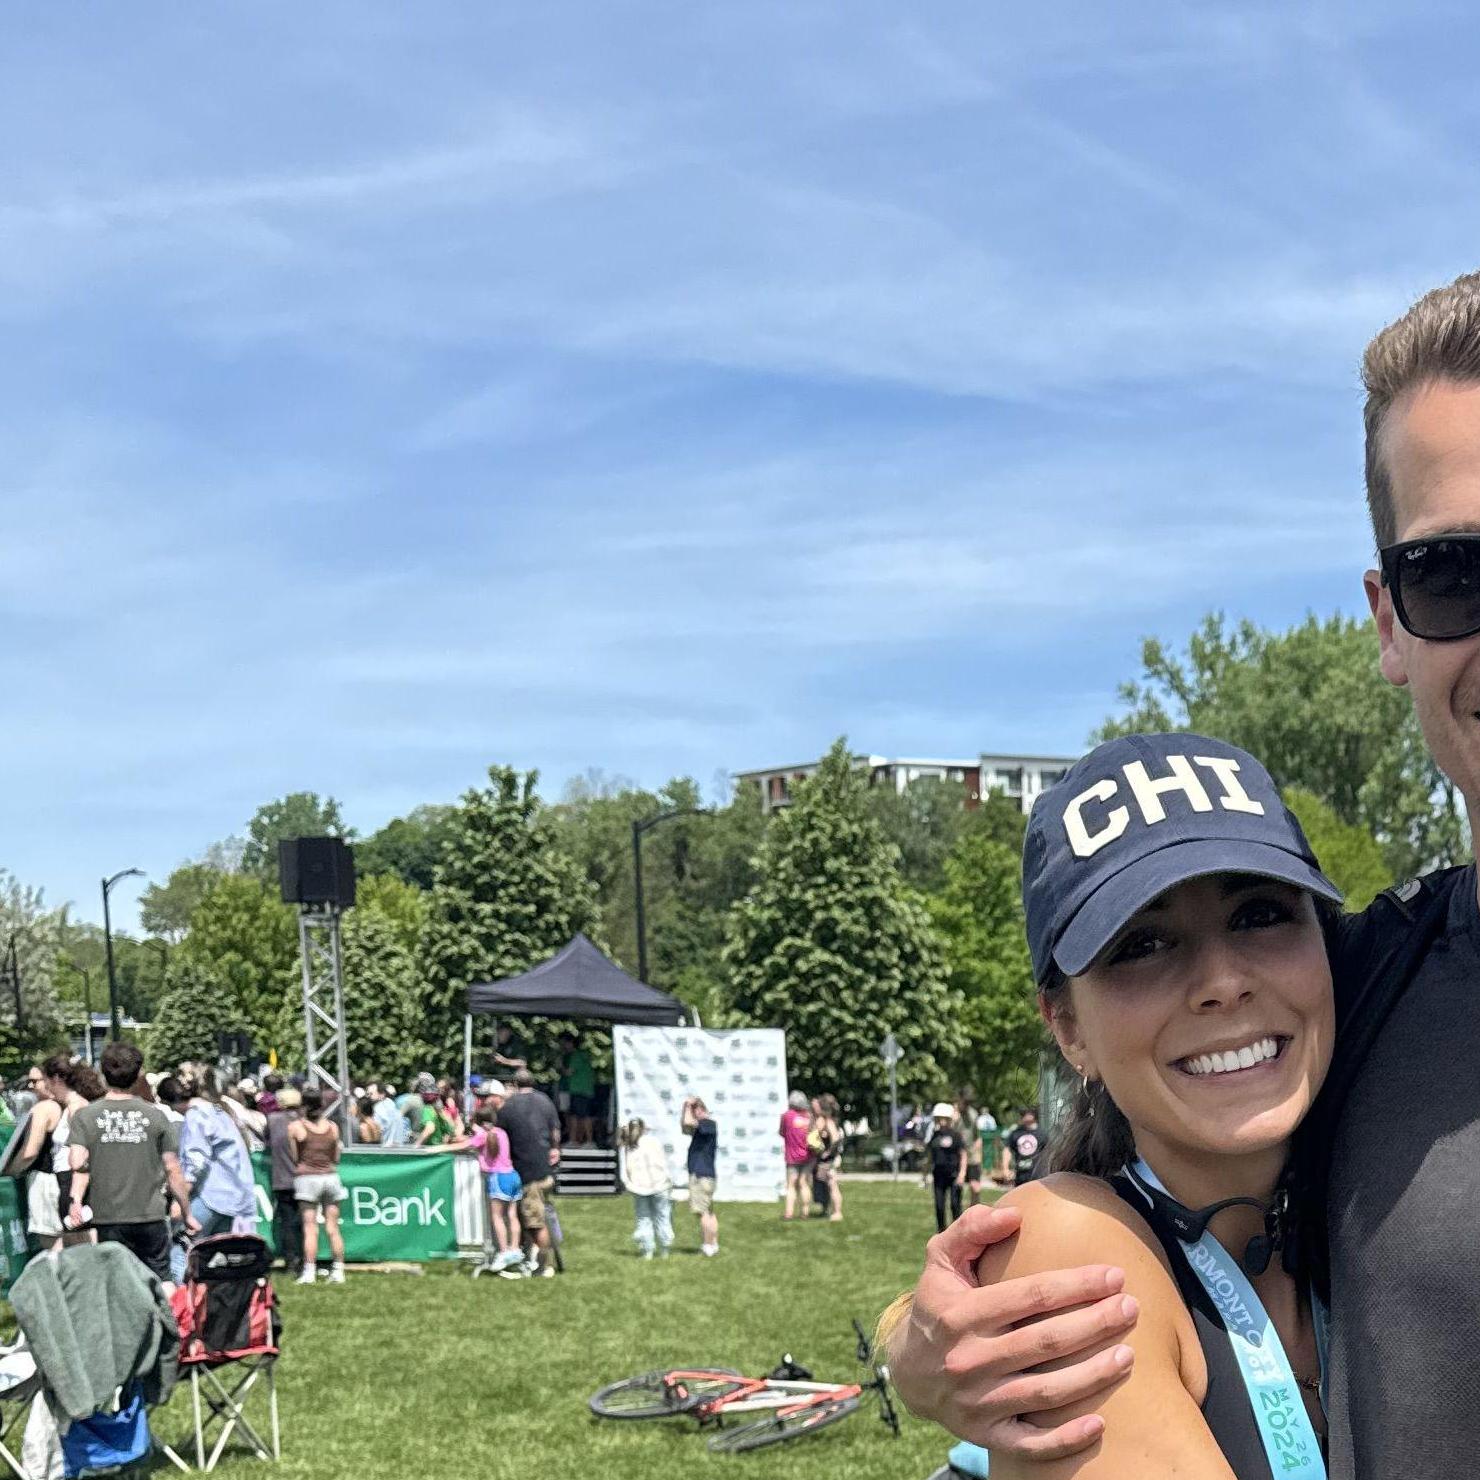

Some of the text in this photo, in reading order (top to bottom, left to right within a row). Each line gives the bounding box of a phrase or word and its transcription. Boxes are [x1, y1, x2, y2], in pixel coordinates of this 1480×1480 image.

[1063, 755, 1265, 857] CHI
[353, 1186, 448, 1226] Bank
[1188, 1245, 1254, 1326] RMONT
[1260, 1390, 1300, 1473] 2024
[1278, 1387, 1312, 1468] MAY 26
